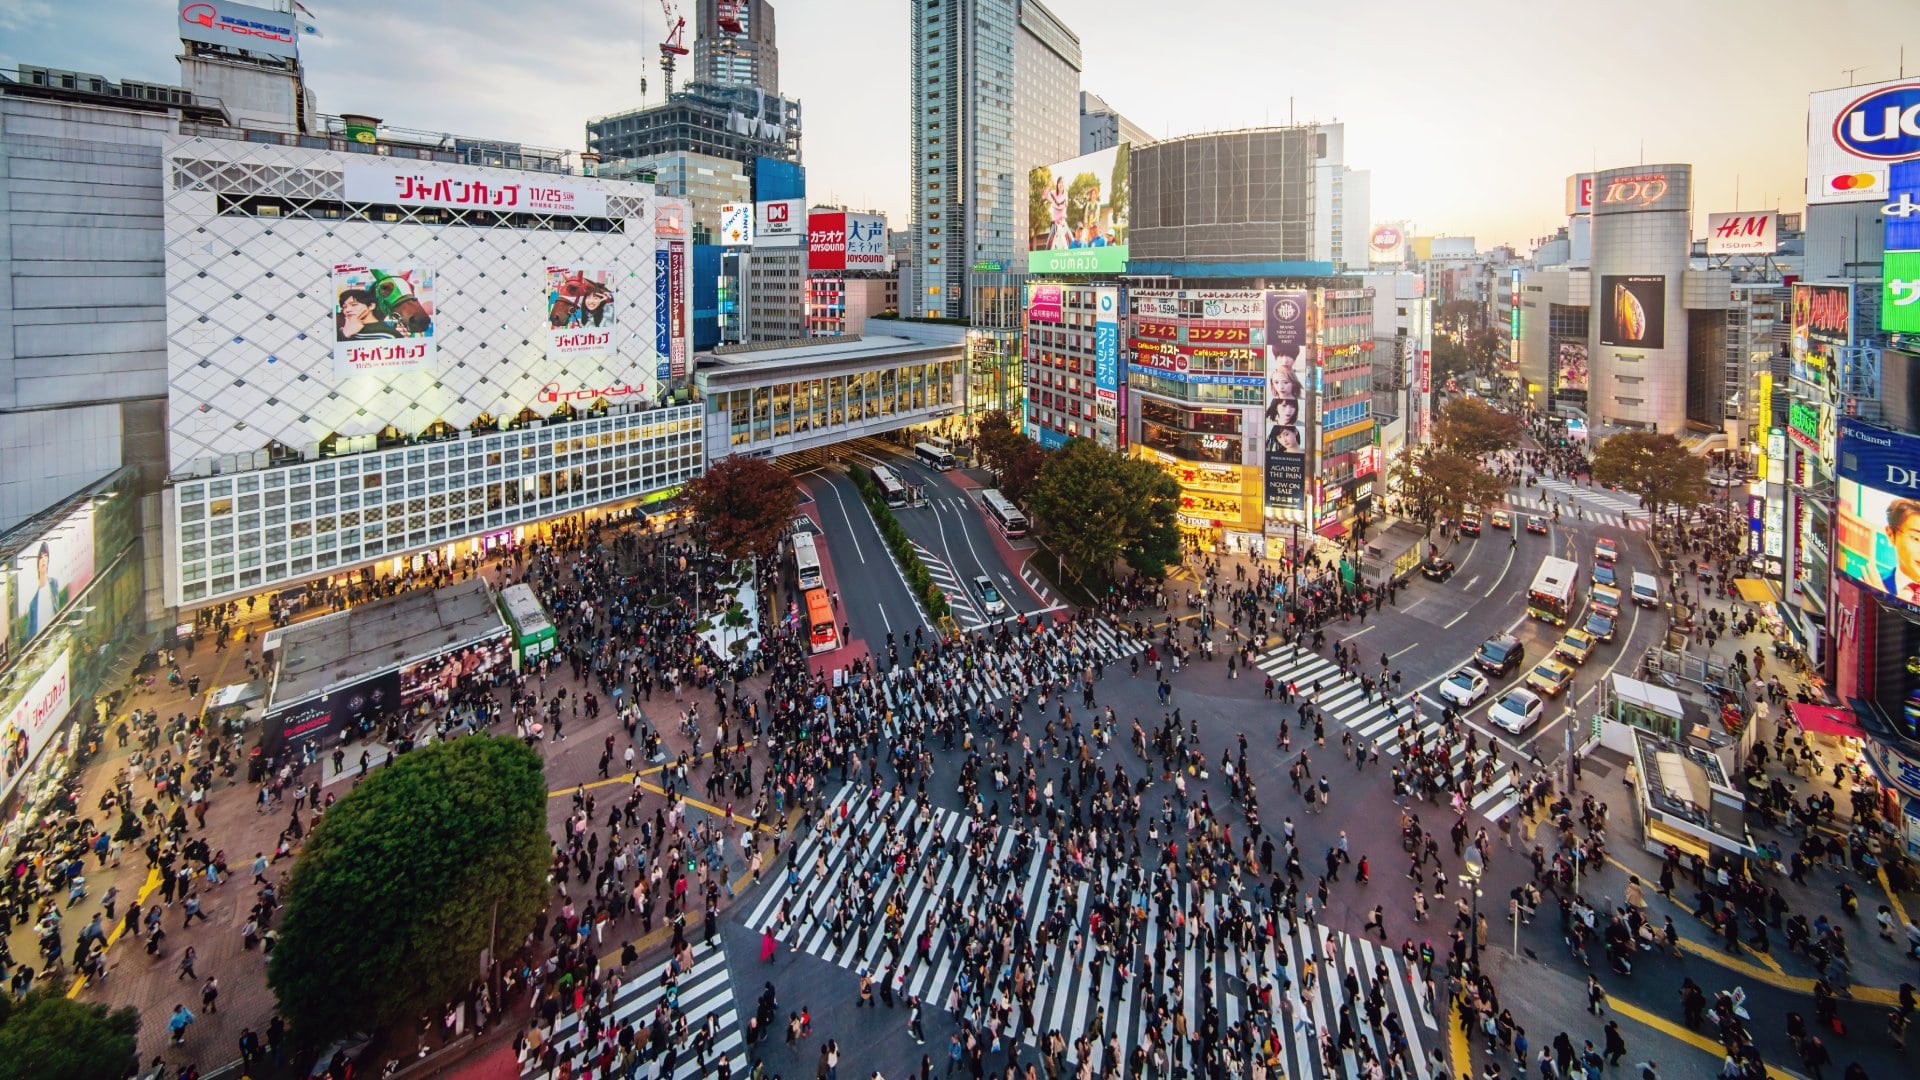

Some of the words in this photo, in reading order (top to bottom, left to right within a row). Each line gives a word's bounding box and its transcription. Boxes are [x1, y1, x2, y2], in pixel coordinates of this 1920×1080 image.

[215, 22, 292, 44] TOKYU
[1614, 174, 1665, 183] SHIBUYA
[395, 175, 521, 206] ジャパンカップ
[529, 188, 560, 202] 11/25
[1602, 180, 1668, 207] 109
[769, 206, 786, 220] DC
[848, 220, 884, 242] 大声
[1716, 216, 1768, 238] H&M
[810, 230, 844, 242] カラオケ
[810, 244, 844, 252] JOYSOUND
[846, 254, 884, 263] JOYSOUND
[1060, 258, 1098, 270] UMAJO
[1140, 324, 1177, 336] プライス
[1189, 329, 1248, 340] コンタクト
[555, 332, 610, 348] ジャパンカップ
[346, 343, 427, 362] ジャパンカップ
[1098, 327, 1108, 384] アイシティ
[1130, 352, 1139, 360] 7F
[1160, 344, 1180, 356] ガスト
[1229, 348, 1258, 360] ガスト
[1150, 354, 1174, 368] ガスト
[1212, 376, 1264, 385] 英会話イーオン
[560, 384, 644, 400] TOKYU
[1097, 402, 1116, 420] No.1
[1842, 426, 1856, 437] DHC
[1856, 432, 1891, 447] Channel
[1356, 481, 1372, 498] LUSH
